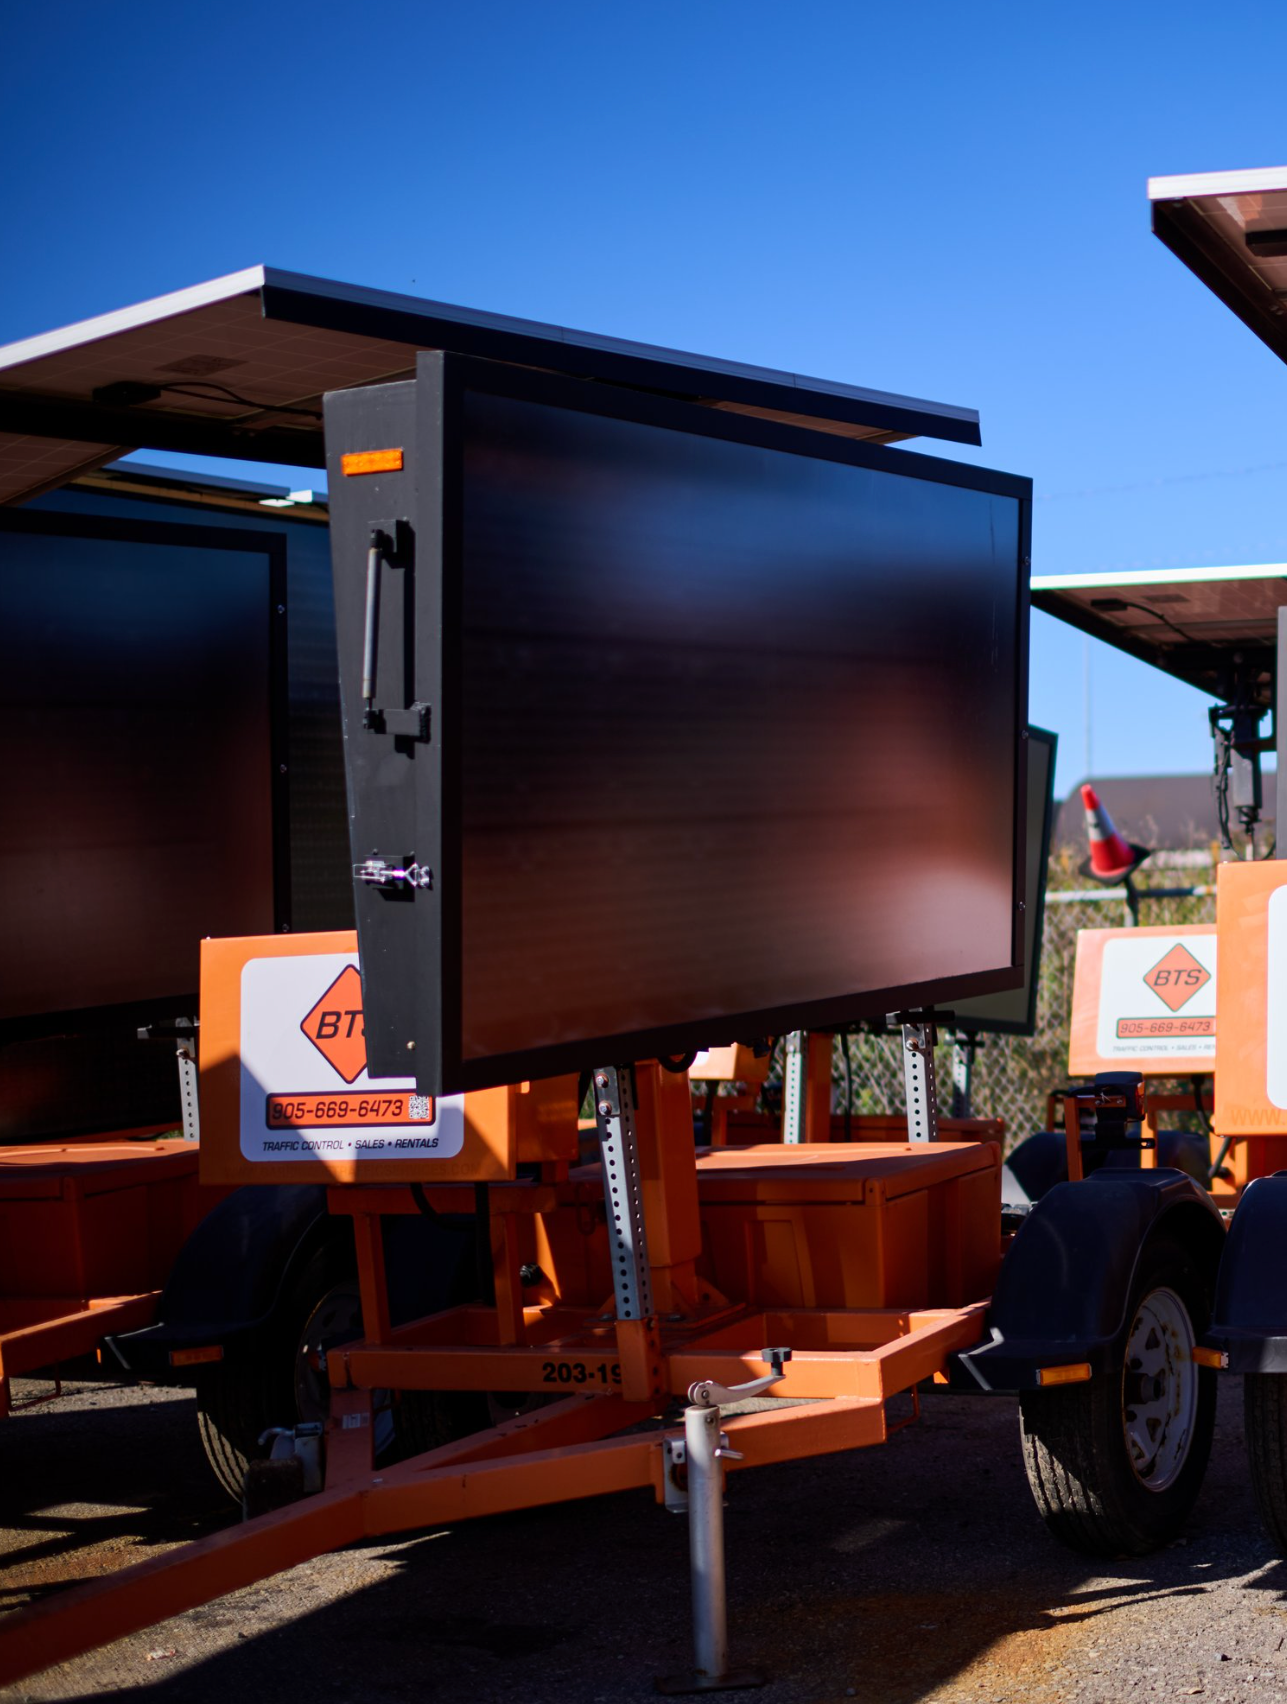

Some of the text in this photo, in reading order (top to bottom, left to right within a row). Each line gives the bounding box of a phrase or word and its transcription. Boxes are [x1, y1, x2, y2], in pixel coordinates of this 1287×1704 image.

[1153, 969, 1202, 986] BTS
[315, 1010, 366, 1039] BT
[1120, 1021, 1211, 1034] 905-669-6473
[271, 1099, 404, 1121] 905-669-6473
[262, 1138, 439, 1151] TRAFFIC CONTROL SALES RENTALS
